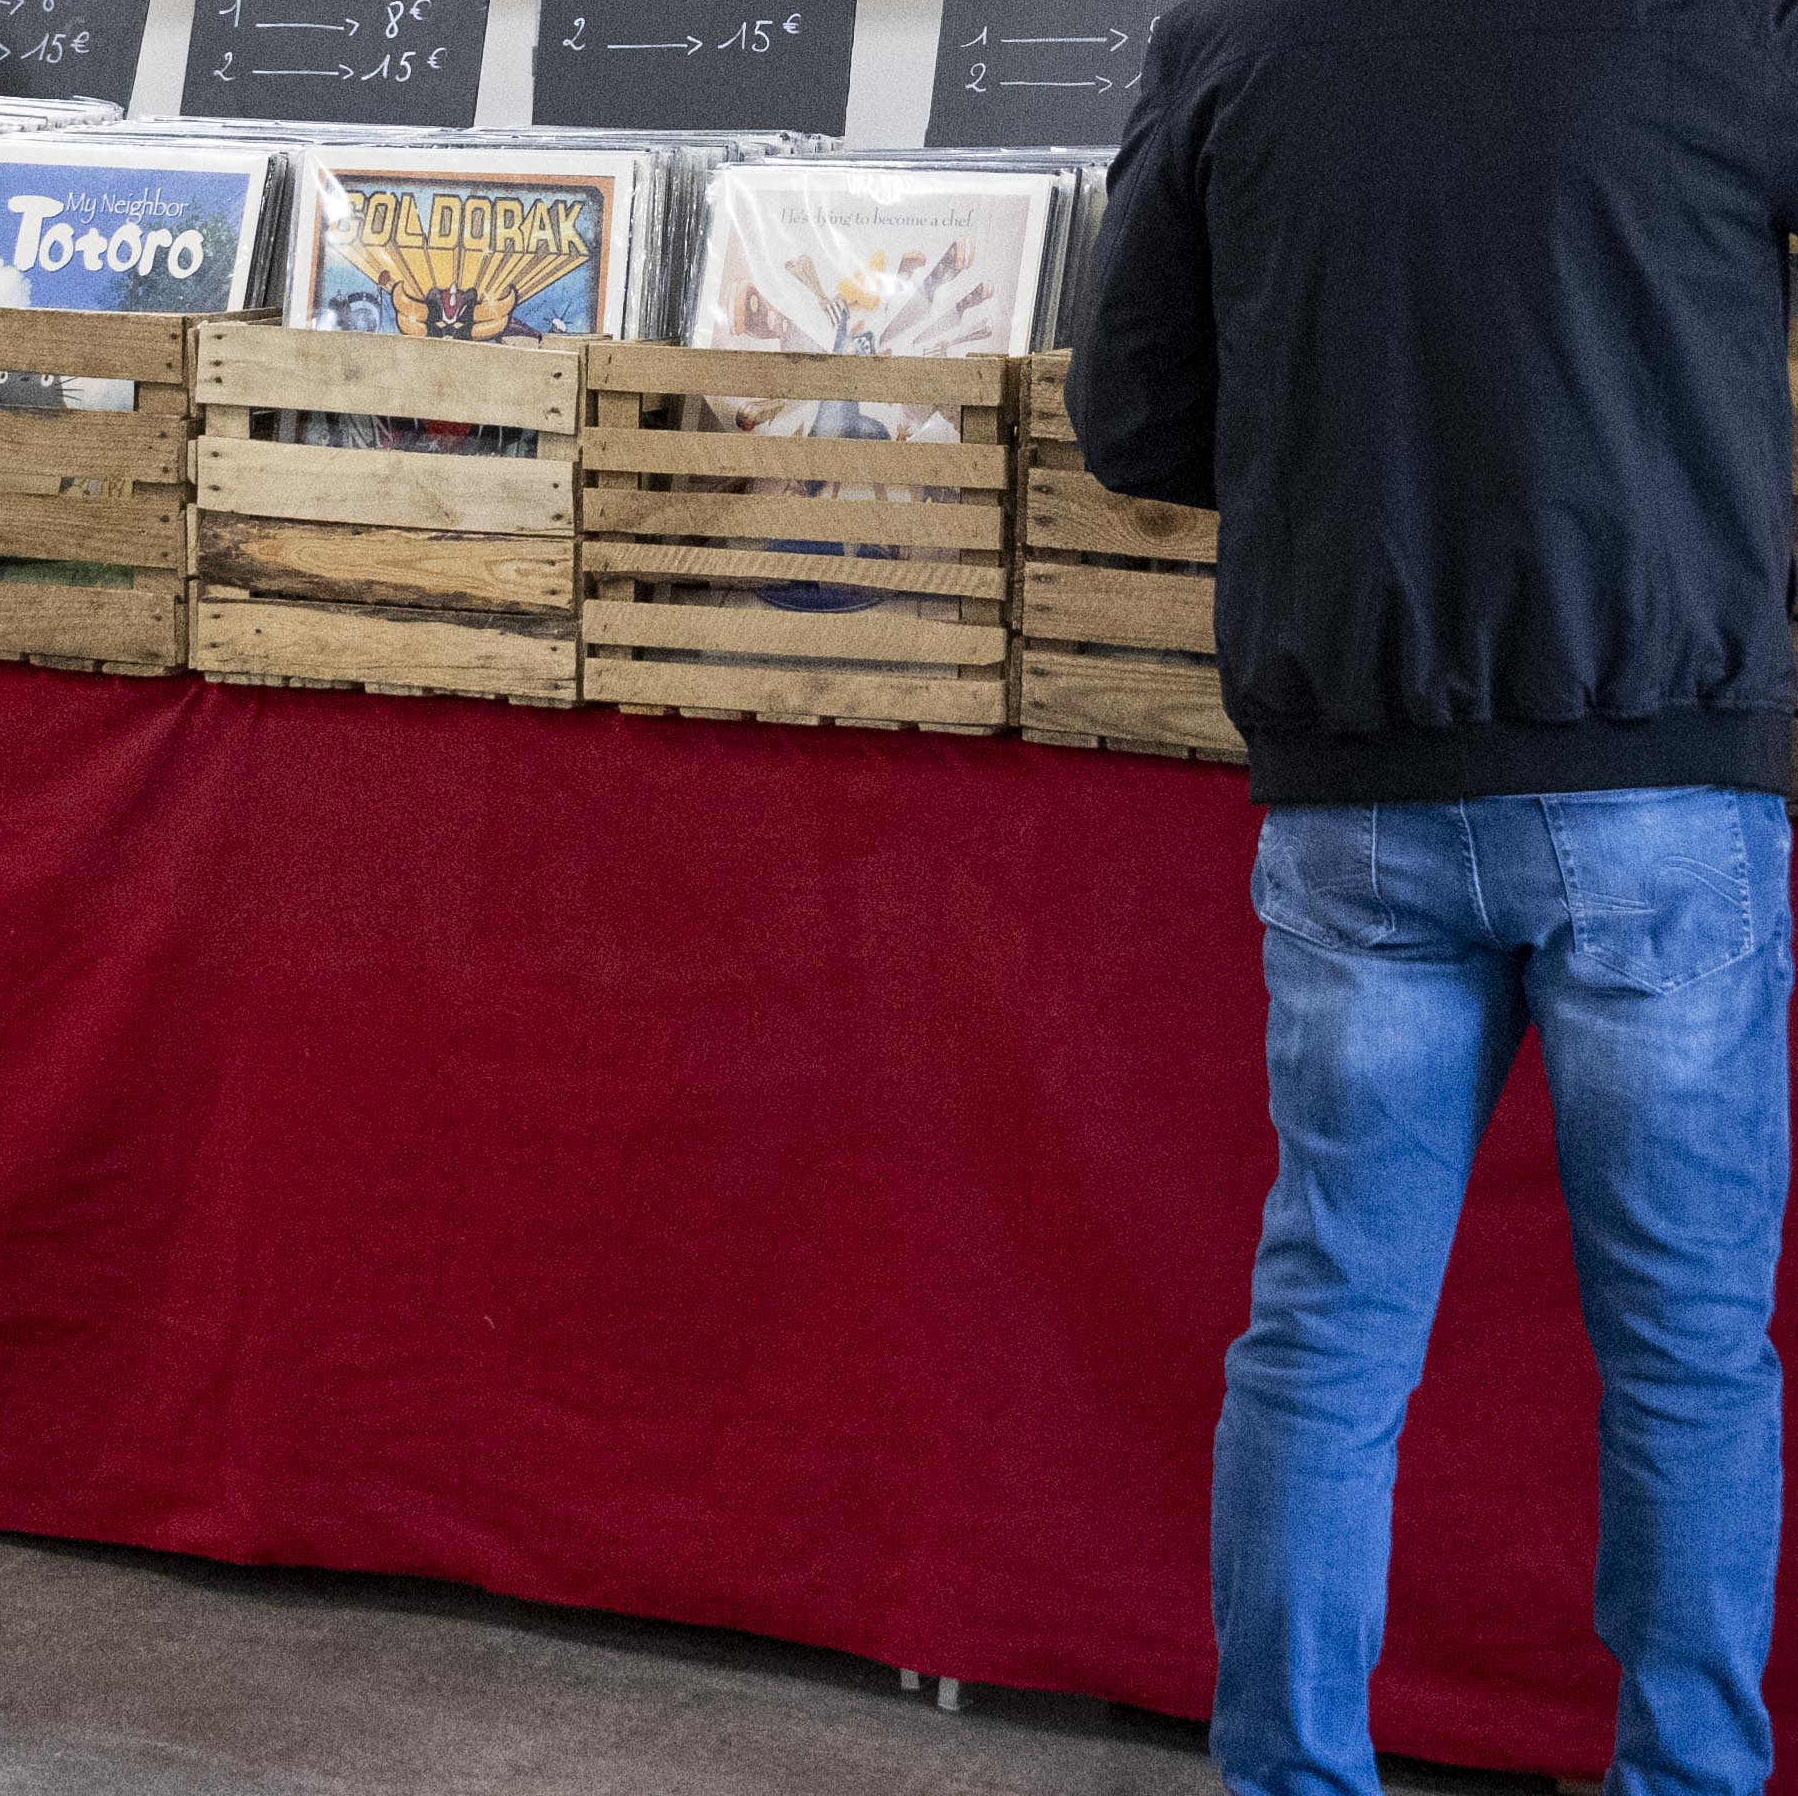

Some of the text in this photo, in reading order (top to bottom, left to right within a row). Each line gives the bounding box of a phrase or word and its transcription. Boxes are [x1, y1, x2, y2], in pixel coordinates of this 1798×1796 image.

[563, 17, 586, 53] 2
[213, 50, 238, 83] 2
[965, 63, 987, 94] 2
[65, 187, 191, 224] My Neighbor
[327, 189, 590, 256] GOLDORAK
[873, 207, 928, 226] become
[7, 194, 205, 280] Totoro
